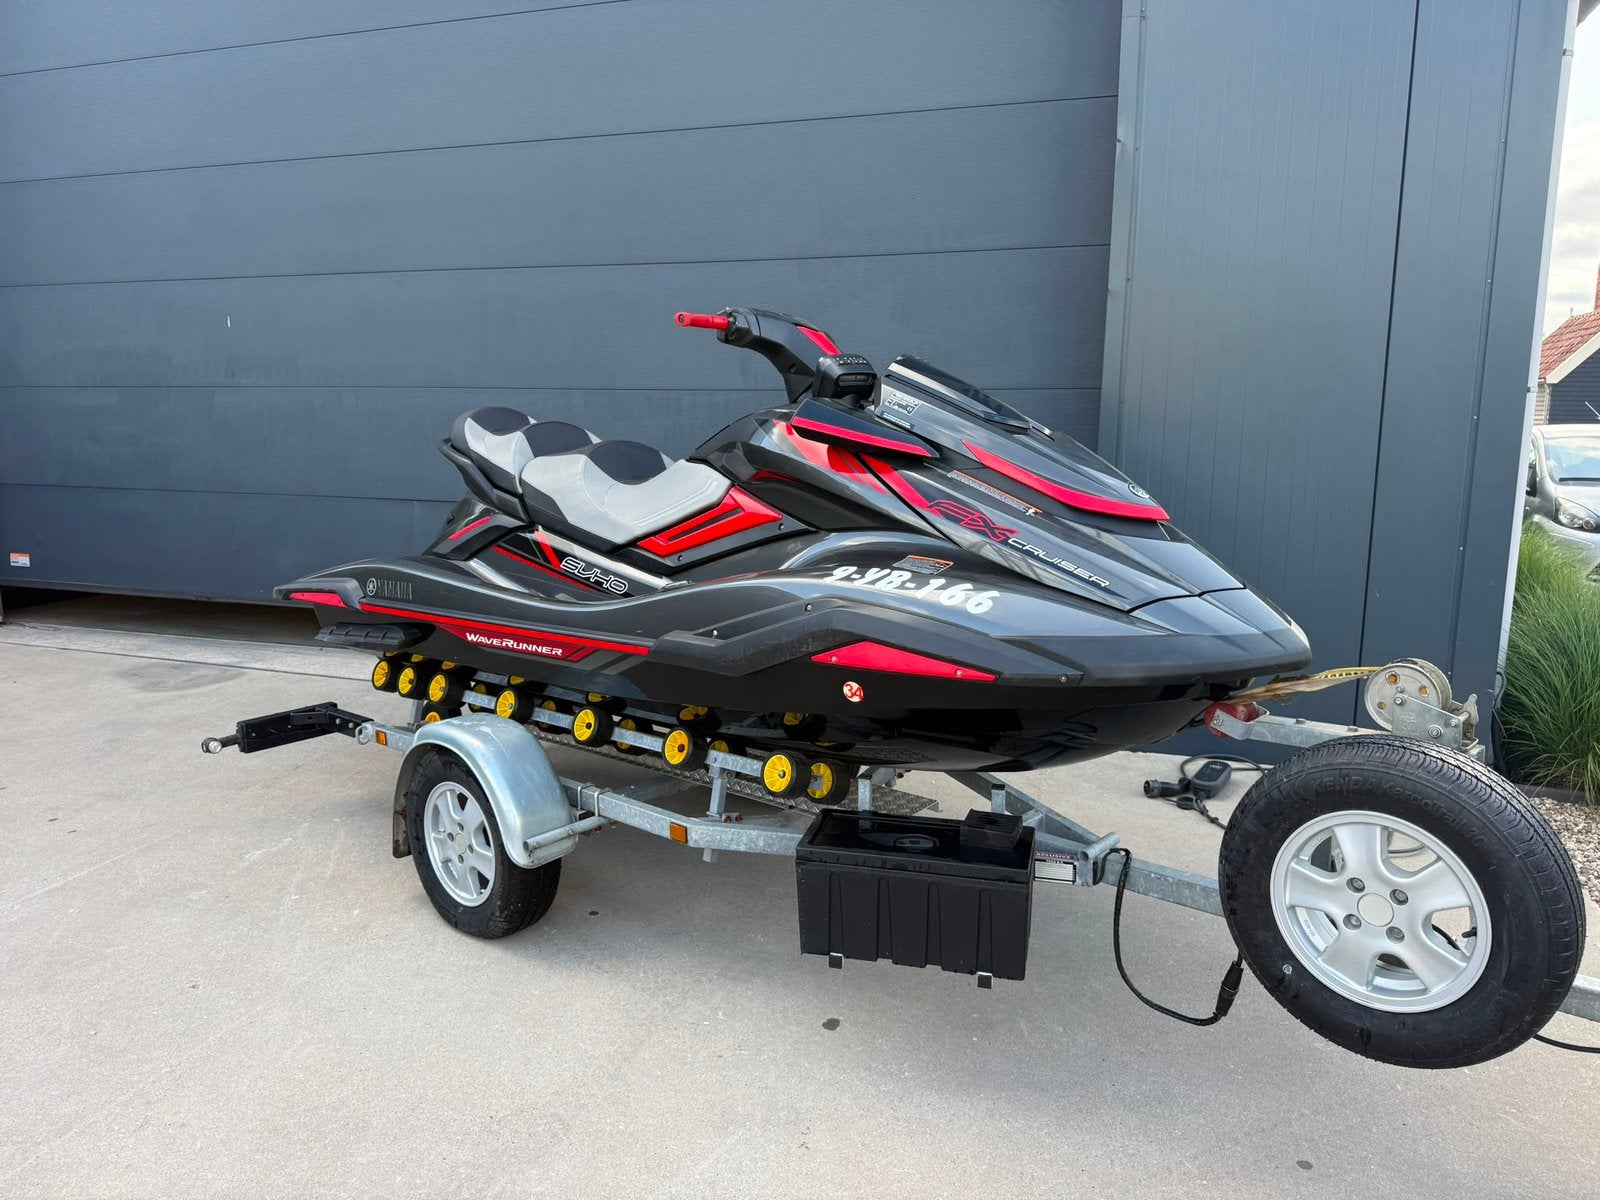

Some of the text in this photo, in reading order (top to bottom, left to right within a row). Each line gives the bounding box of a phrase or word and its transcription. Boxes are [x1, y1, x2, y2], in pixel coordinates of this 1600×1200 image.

[927, 499, 1019, 542] FX
[1007, 537, 1112, 588] CRUISER
[560, 556, 629, 594] SVHO
[822, 566, 1000, 614] 9-YB-166
